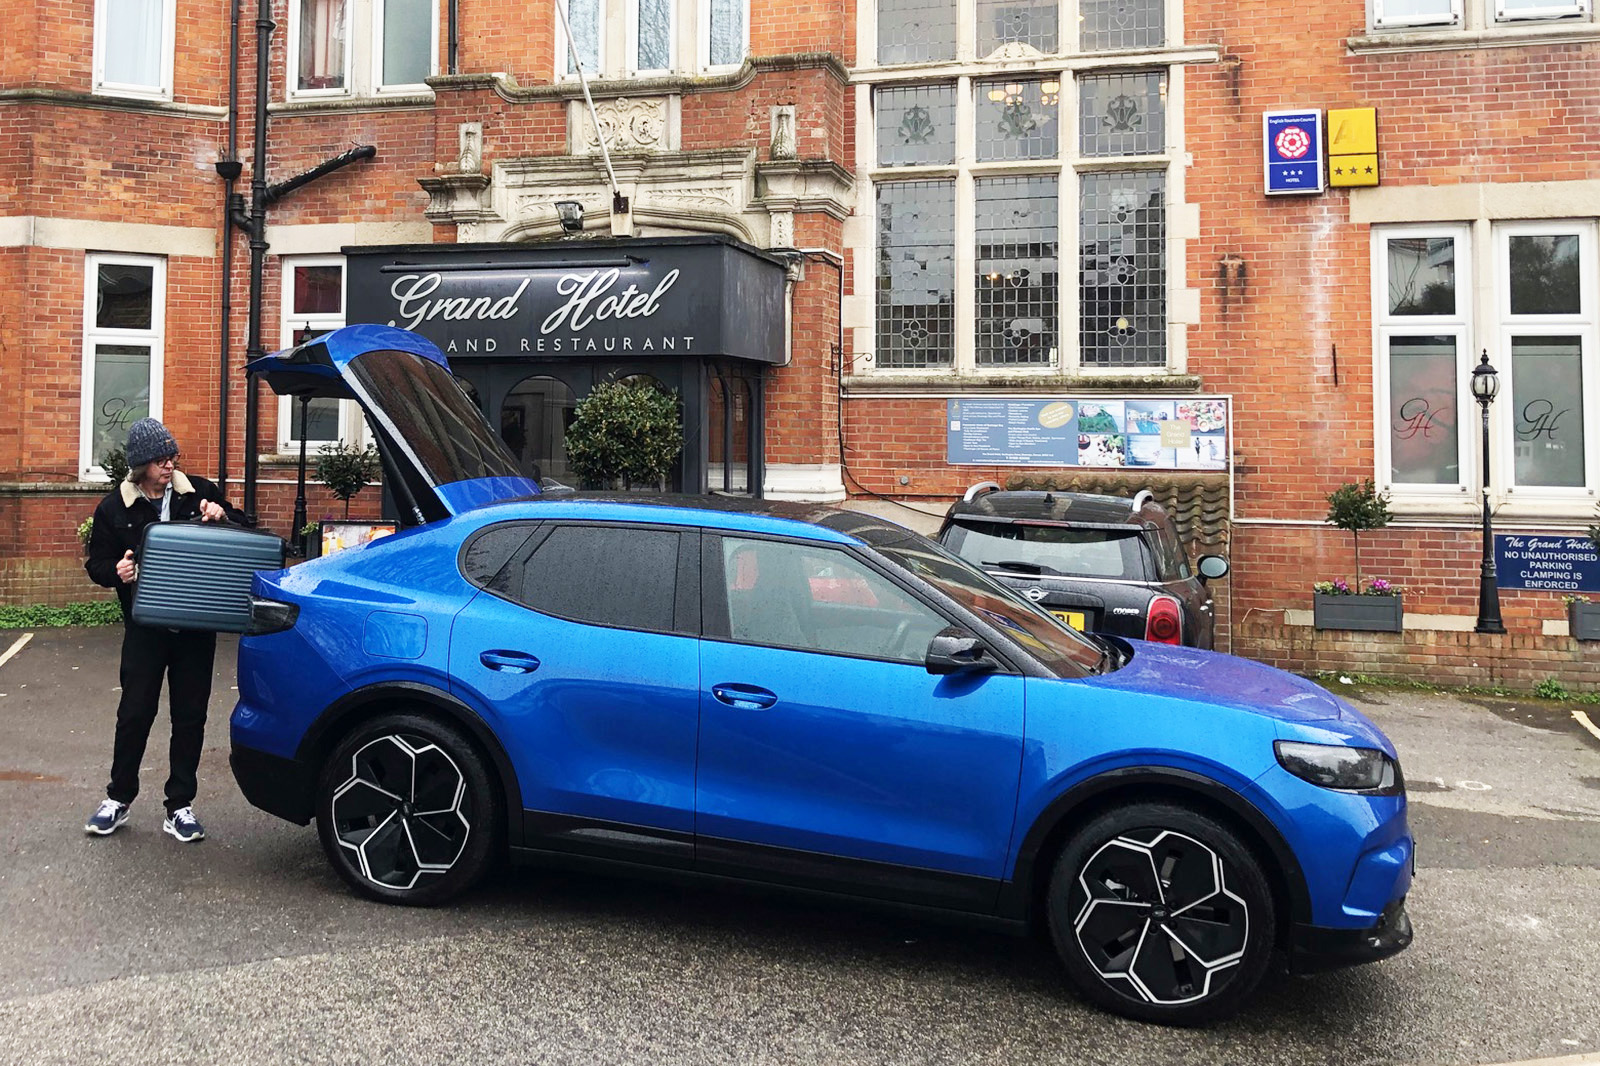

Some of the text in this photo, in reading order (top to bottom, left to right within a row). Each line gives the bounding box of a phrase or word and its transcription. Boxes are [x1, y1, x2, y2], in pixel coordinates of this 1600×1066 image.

[387, 268, 680, 335] Grand Hotel
[447, 336, 694, 352] AND RESTAURANT
[1505, 537, 1524, 548] The
[1527, 538, 1562, 551] Grand
[1504, 551, 1598, 561] NO UNAUTHORISED
[1529, 561, 1572, 570] PARKING
[1520, 570, 1582, 580] CLAMPING IS
[1525, 580, 1578, 589] ENFORCED
